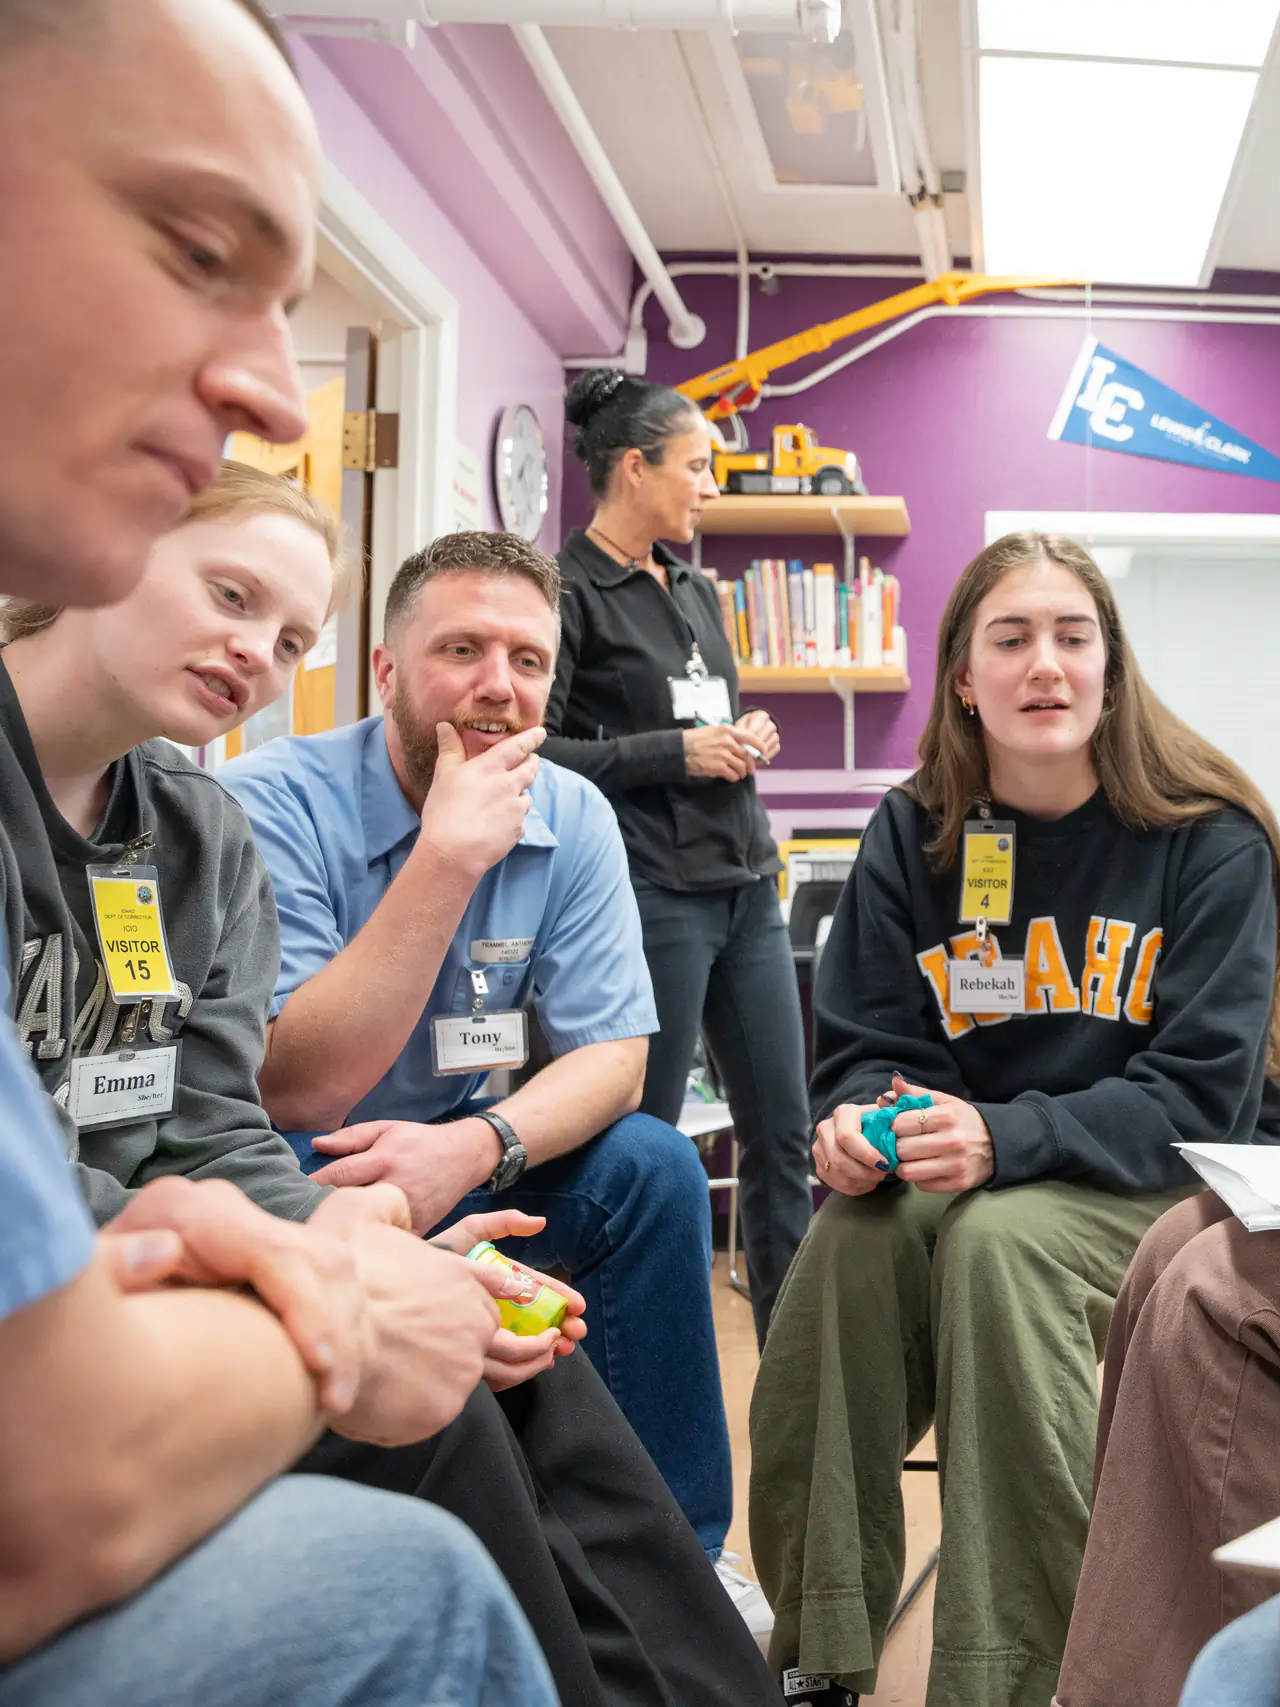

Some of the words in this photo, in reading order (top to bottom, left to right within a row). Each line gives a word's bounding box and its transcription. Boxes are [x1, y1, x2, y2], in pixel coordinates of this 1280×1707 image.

[967, 878, 1008, 889] VISITOR
[980, 893, 990, 909] 4
[106, 940, 161, 953] VISITOR
[125, 959, 151, 980] 15
[960, 976, 1016, 990] Rebekah
[459, 1031, 502, 1047] Tony
[93, 1073, 156, 1095] Emma
